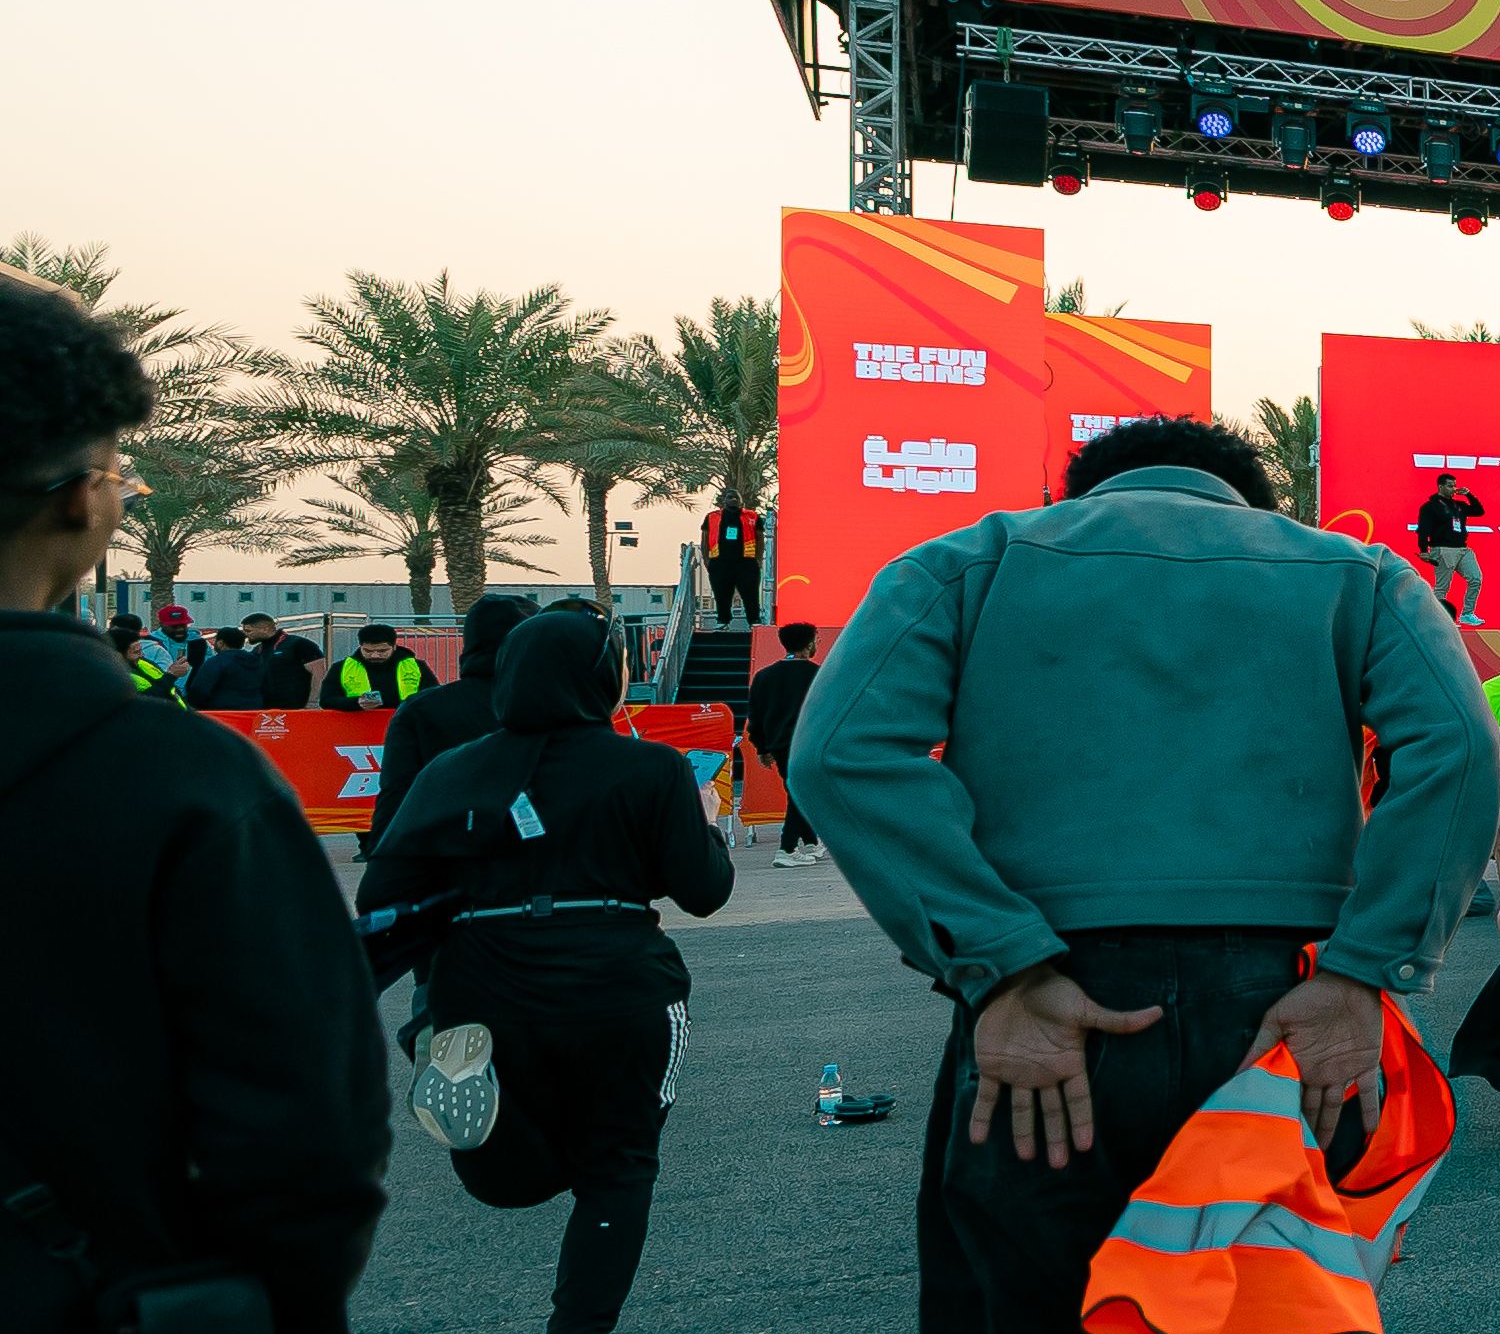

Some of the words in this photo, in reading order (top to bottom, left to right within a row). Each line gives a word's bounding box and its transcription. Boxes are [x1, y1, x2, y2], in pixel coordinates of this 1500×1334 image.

[853, 342, 914, 362] THE
[918, 346, 987, 367] FUN
[855, 359, 987, 386] BEGINS
[1070, 414, 1116, 429] THE
[863, 434, 977, 468] متعة
